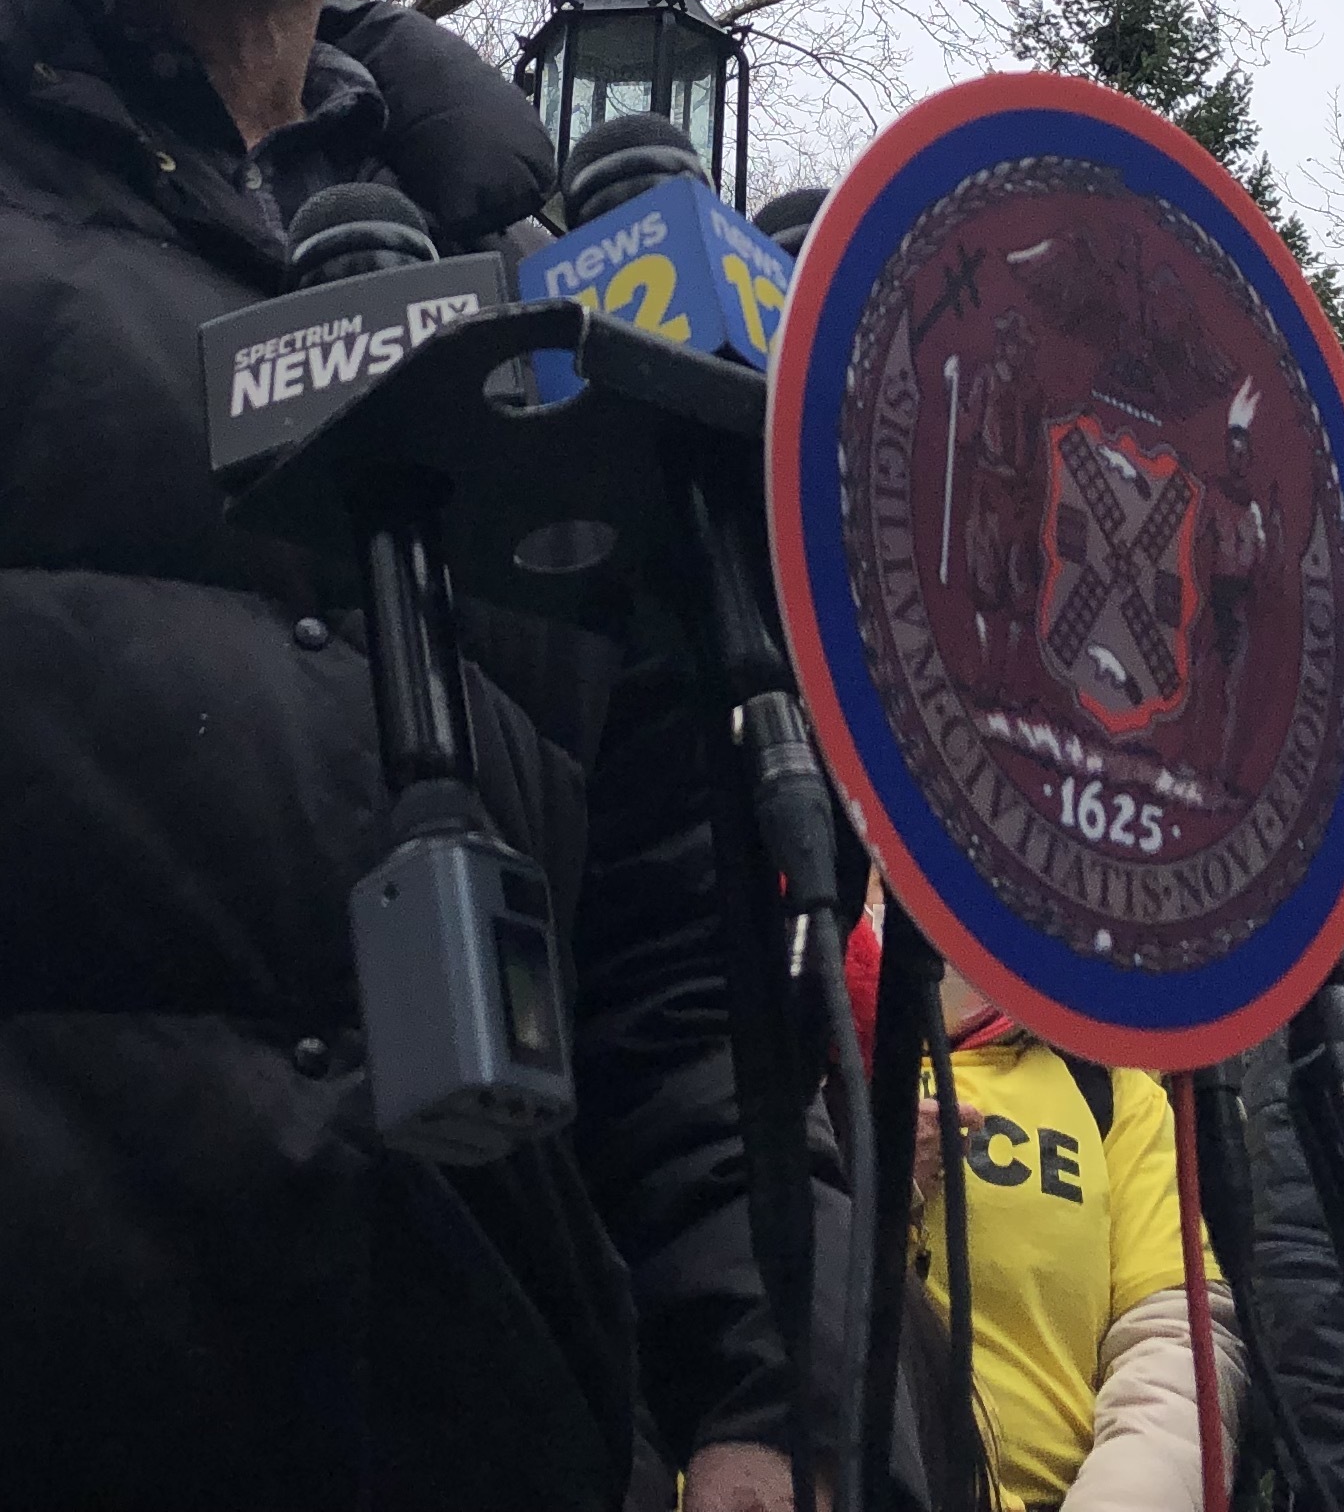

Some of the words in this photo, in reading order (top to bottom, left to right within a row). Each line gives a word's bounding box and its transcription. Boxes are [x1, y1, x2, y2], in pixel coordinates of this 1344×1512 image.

[546, 211, 668, 298] news
[230, 325, 404, 417] NEWS
[235, 315, 362, 369] SPECTRUM
[1060, 776, 1164, 855] 1625
